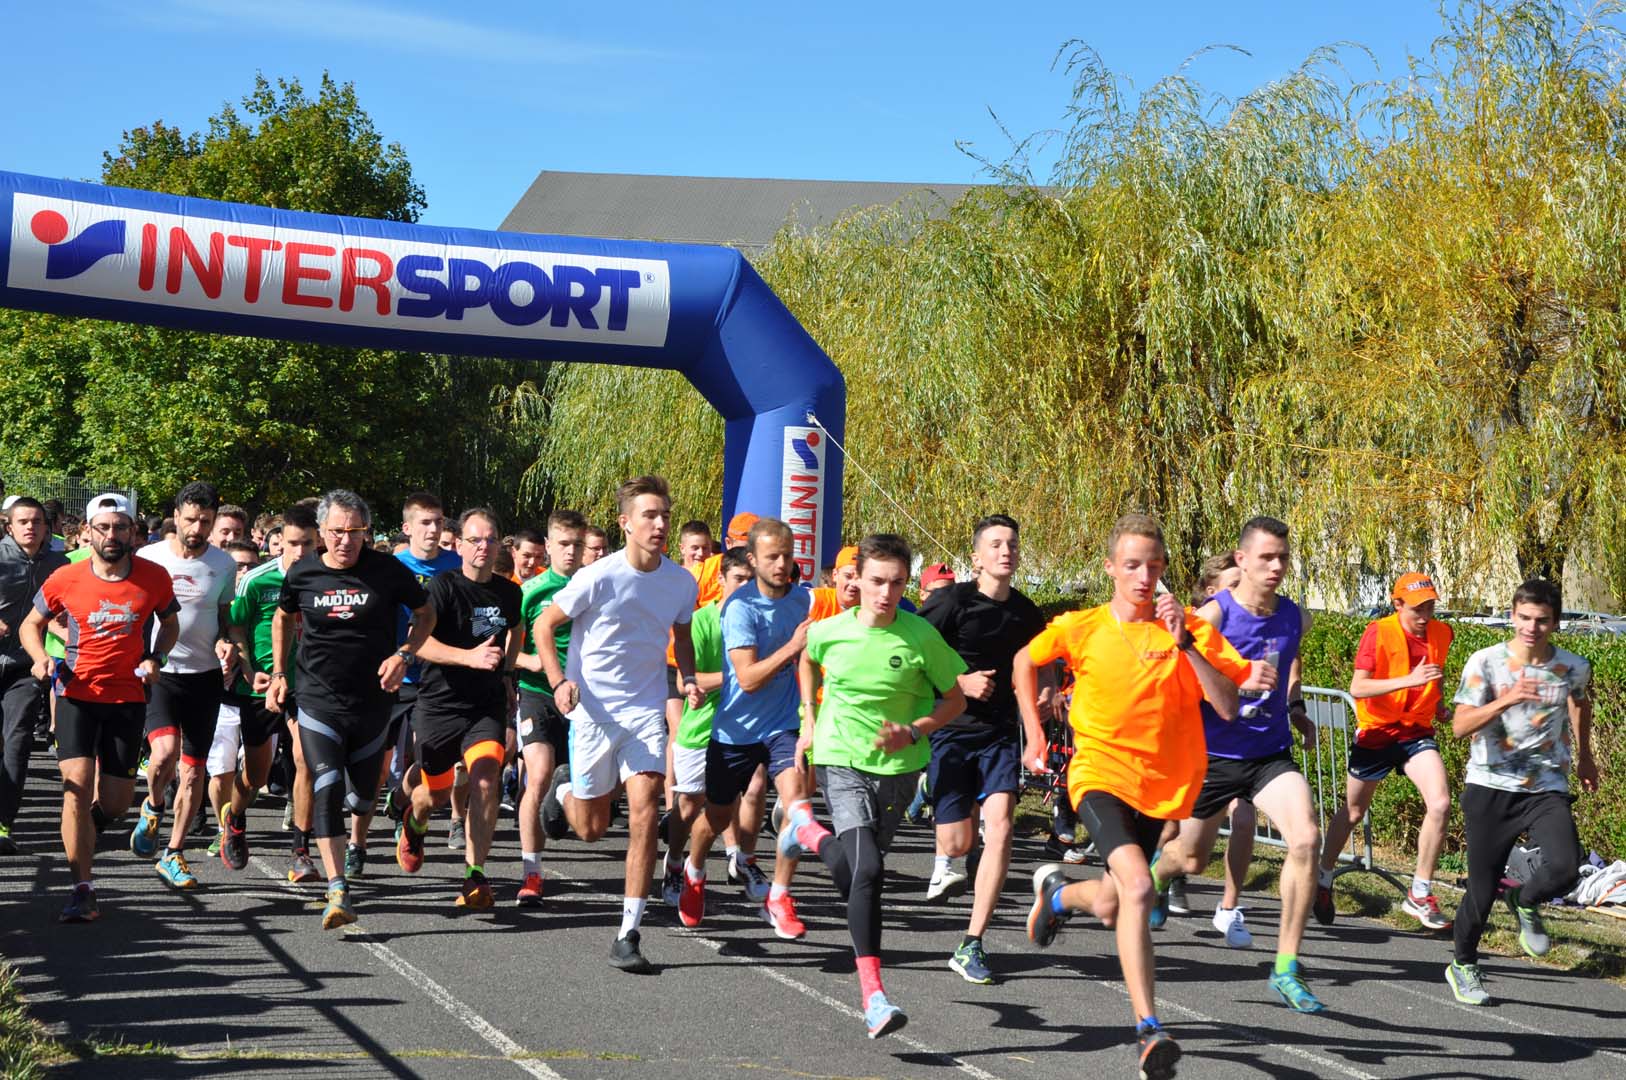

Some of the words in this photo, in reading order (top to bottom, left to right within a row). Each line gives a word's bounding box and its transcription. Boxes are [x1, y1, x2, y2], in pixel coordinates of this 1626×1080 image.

[138, 222, 641, 331] INTERSPORT
[788, 474, 819, 588] INTER
[314, 595, 342, 607] MUD
[344, 593, 369, 605] DAY
